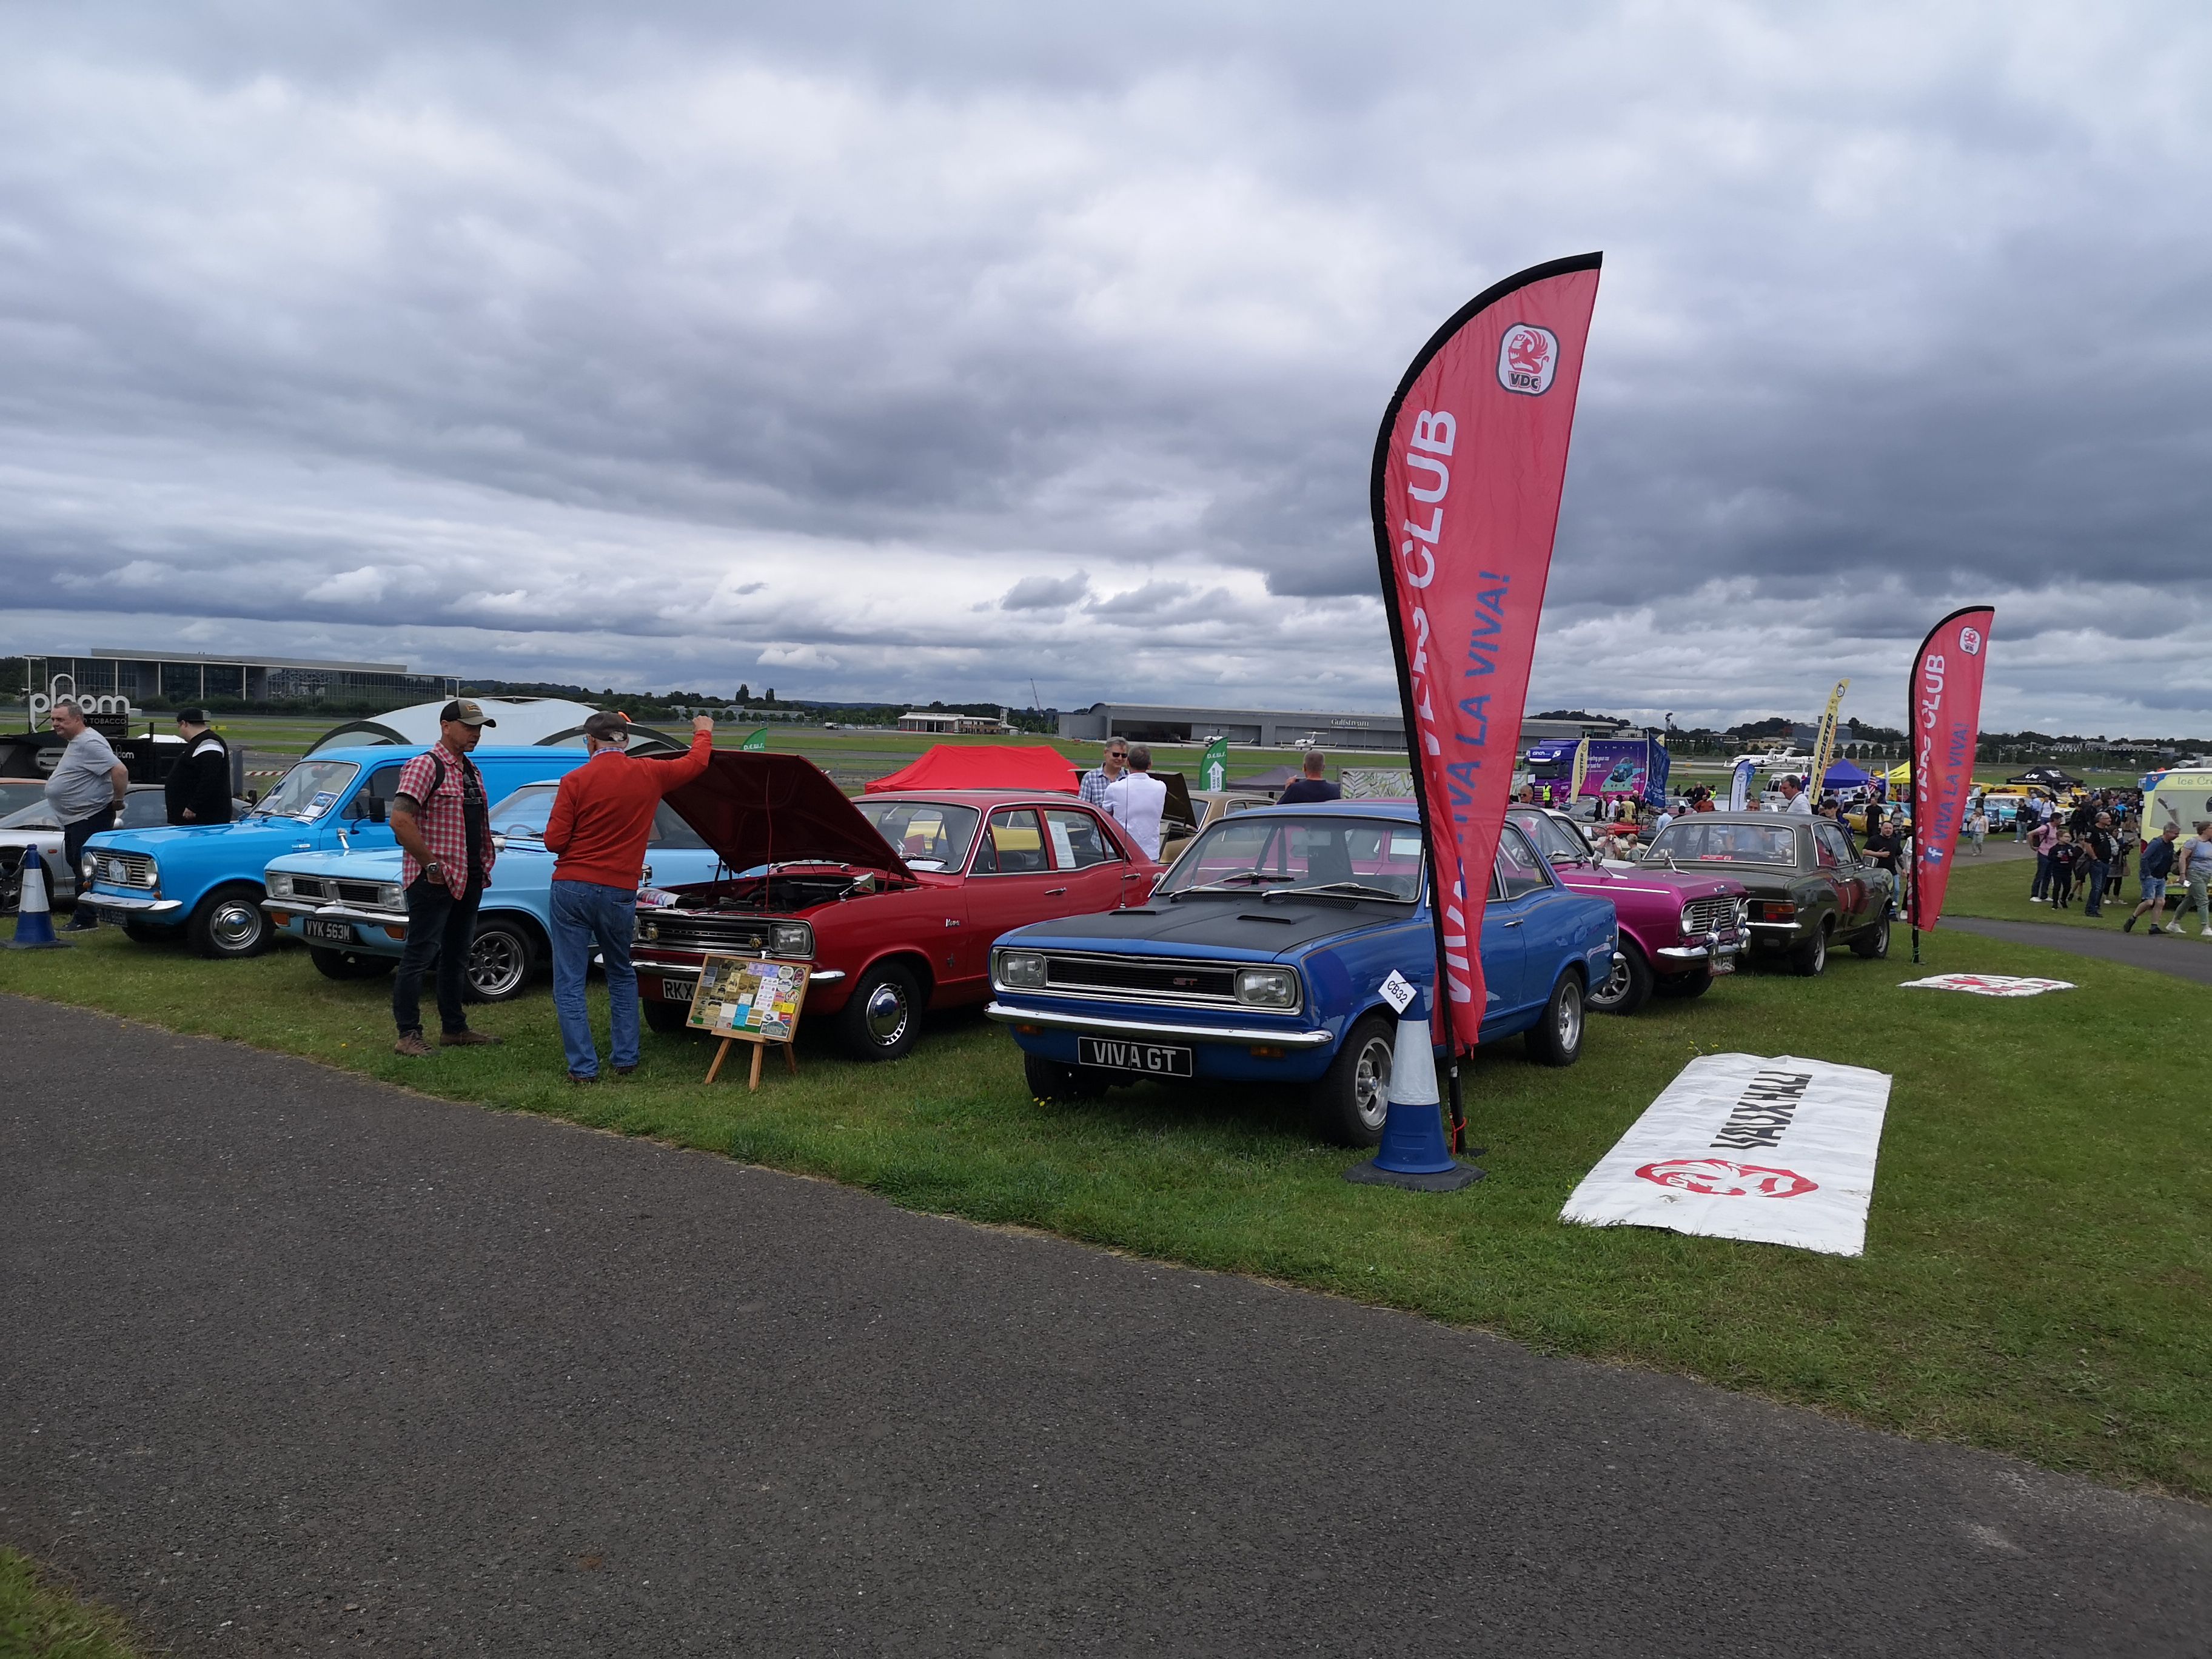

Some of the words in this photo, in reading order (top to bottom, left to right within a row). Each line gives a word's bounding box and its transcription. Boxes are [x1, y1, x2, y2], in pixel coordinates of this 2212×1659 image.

[1510, 373, 1540, 389] VDC
[1403, 409, 1457, 588] CLUB
[1465, 571, 1510, 677] VIVA!
[1922, 654, 1945, 729] CLUB
[1455, 695, 1491, 746] LA
[1818, 712, 1834, 770] REGISTER
[1948, 723, 1970, 767] VIVA!
[1944, 774, 1960, 796] LA
[2177, 776, 2193, 785] Ice
[1932, 802, 1954, 839] VIVA
[307, 920, 324, 937] VYK
[326, 923, 350, 940] 563M
[664, 981, 694, 1000] RKX
[1173, 977, 1198, 986] GT
[1387, 980, 1408, 1004] CB32
[1093, 1041, 1141, 1068] VIVA
[1147, 1048, 1176, 1071] GT
[1709, 1071, 1813, 1150] VAUXHALL
